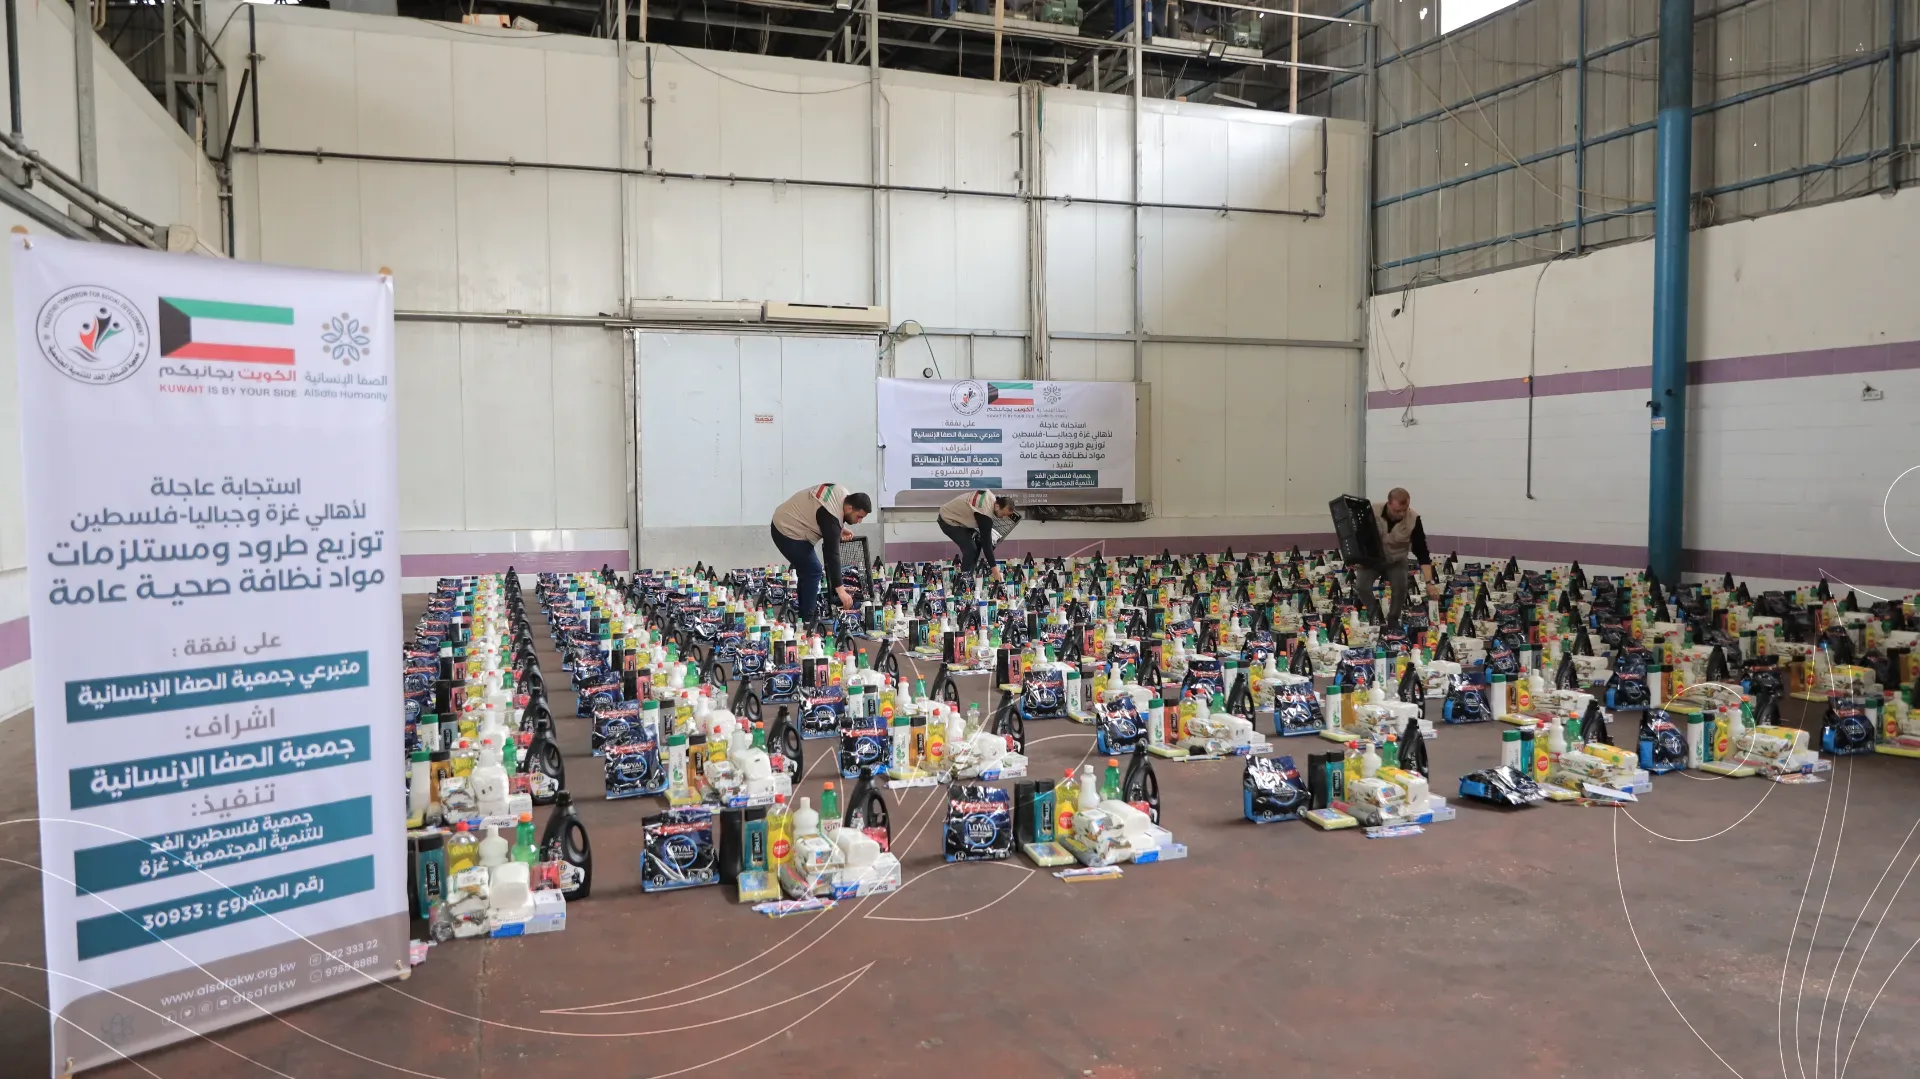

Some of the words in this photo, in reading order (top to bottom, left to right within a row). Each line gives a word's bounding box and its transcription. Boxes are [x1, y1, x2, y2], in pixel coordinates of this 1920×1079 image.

[57, 291, 88, 305] TOMORROW
[159, 364, 235, 381] بجانبكم
[238, 369, 297, 383] الكويت
[159, 384, 204, 394] KUWAIT
[207, 386, 219, 395] IS
[222, 387, 236, 396] BY
[239, 387, 270, 397] YOUR
[273, 388, 297, 398] SIDE
[340, 389, 388, 402] Humanity
[957, 431, 979, 440] جمعية
[1039, 421, 1059, 431] عاجلة
[1019, 441, 1064, 450] ومستلزمات
[1019, 452, 1038, 460] عامة
[1064, 441, 1084, 450] طرود
[1085, 440, 1106, 451] توزيع
[1088, 452, 1106, 461] مواد
[934, 466, 969, 477] المشروع
[969, 467, 984, 477] رقم
[972, 455, 1000, 466] جمعية
[150, 478, 216, 503] عاجلة
[222, 477, 301, 502] استجابة
[943, 480, 971, 488] 30933
[265, 504, 300, 524] غزة
[305, 500, 367, 531] لأهالي
[47, 539, 230, 571] ومستلزمات
[238, 534, 308, 561] طرود
[315, 530, 384, 562] توزيع
[239, 566, 322, 594] نظافة
[329, 565, 386, 594] مواد
[48, 578, 127, 607] عامة
[183, 637, 237, 657] نفقة
[243, 632, 282, 656] على
[174, 672, 227, 696] الصفا
[231, 665, 296, 692] جمعية
[299, 660, 361, 690] متبرعي
[77, 677, 170, 709] الإنسانية
[209, 745, 273, 774] الصفا
[278, 736, 356, 766] جمعية
[90, 757, 205, 798] الإنسانية
[262, 811, 314, 834] جمعية
[968, 823, 992, 832] LOYAL
[150, 834, 185, 854] الغد
[187, 818, 259, 852] فلسطين
[269, 825, 324, 852] للتنمية
[139, 852, 169, 878] غزة
[183, 834, 267, 872] المجتمعية
[292, 875, 325, 900] رقم
[216, 883, 289, 919] المشروع
[142, 903, 204, 932] 30933
[345, 943, 364, 956] 333
[366, 939, 379, 952] 22
[160, 960, 297, 1008] www.alsafakw.org.kw
[232, 977, 297, 1005] alsafakw
